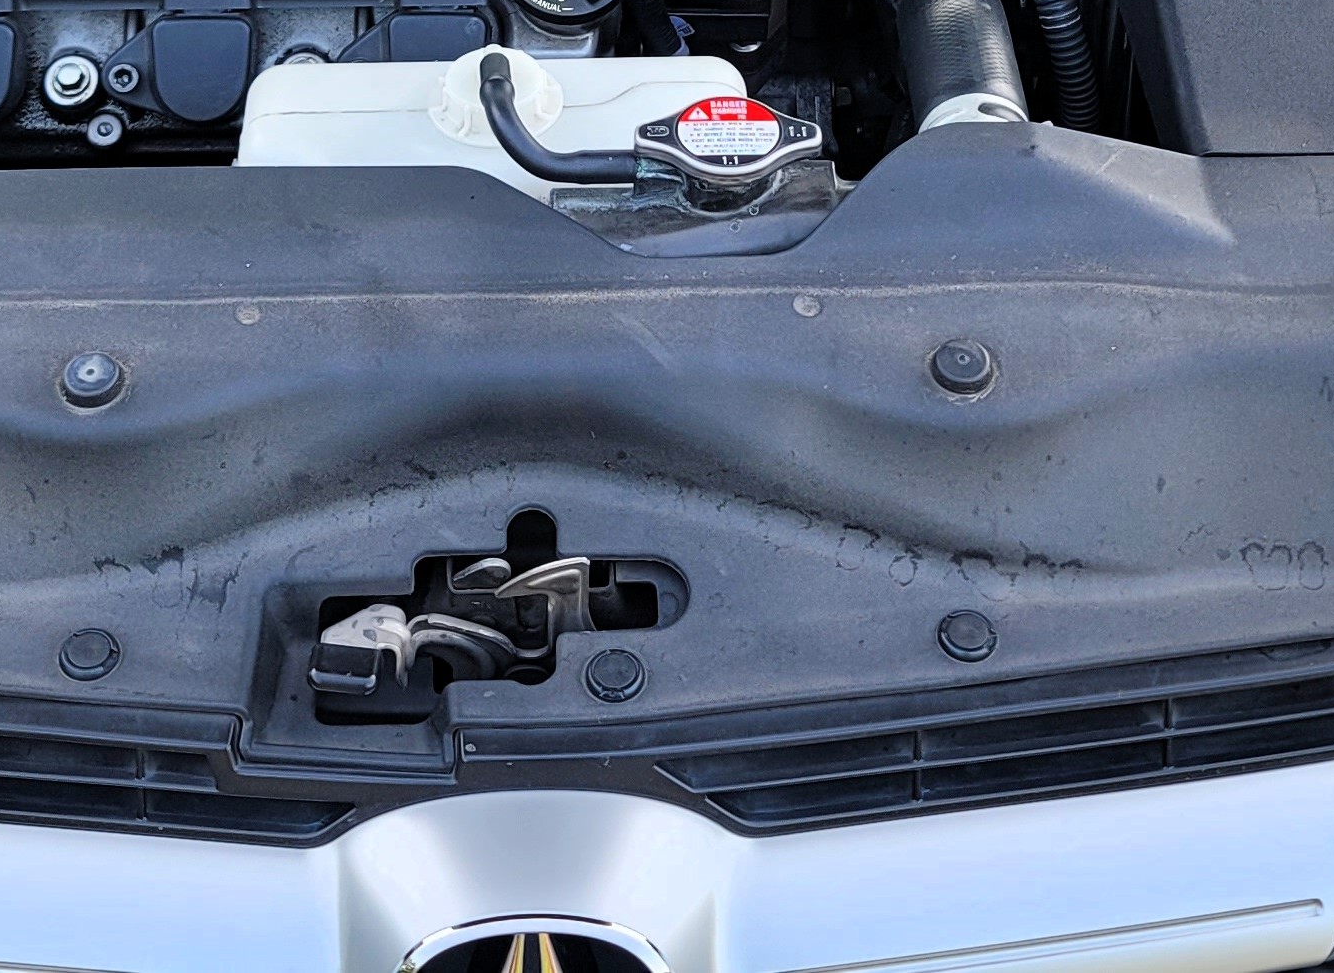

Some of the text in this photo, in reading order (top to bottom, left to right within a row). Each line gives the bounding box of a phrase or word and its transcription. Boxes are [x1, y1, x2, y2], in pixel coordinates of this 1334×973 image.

[710, 100, 747, 108] DANGER
[788, 126, 807, 137] 1.1
[722, 156, 739, 165] 1.1
